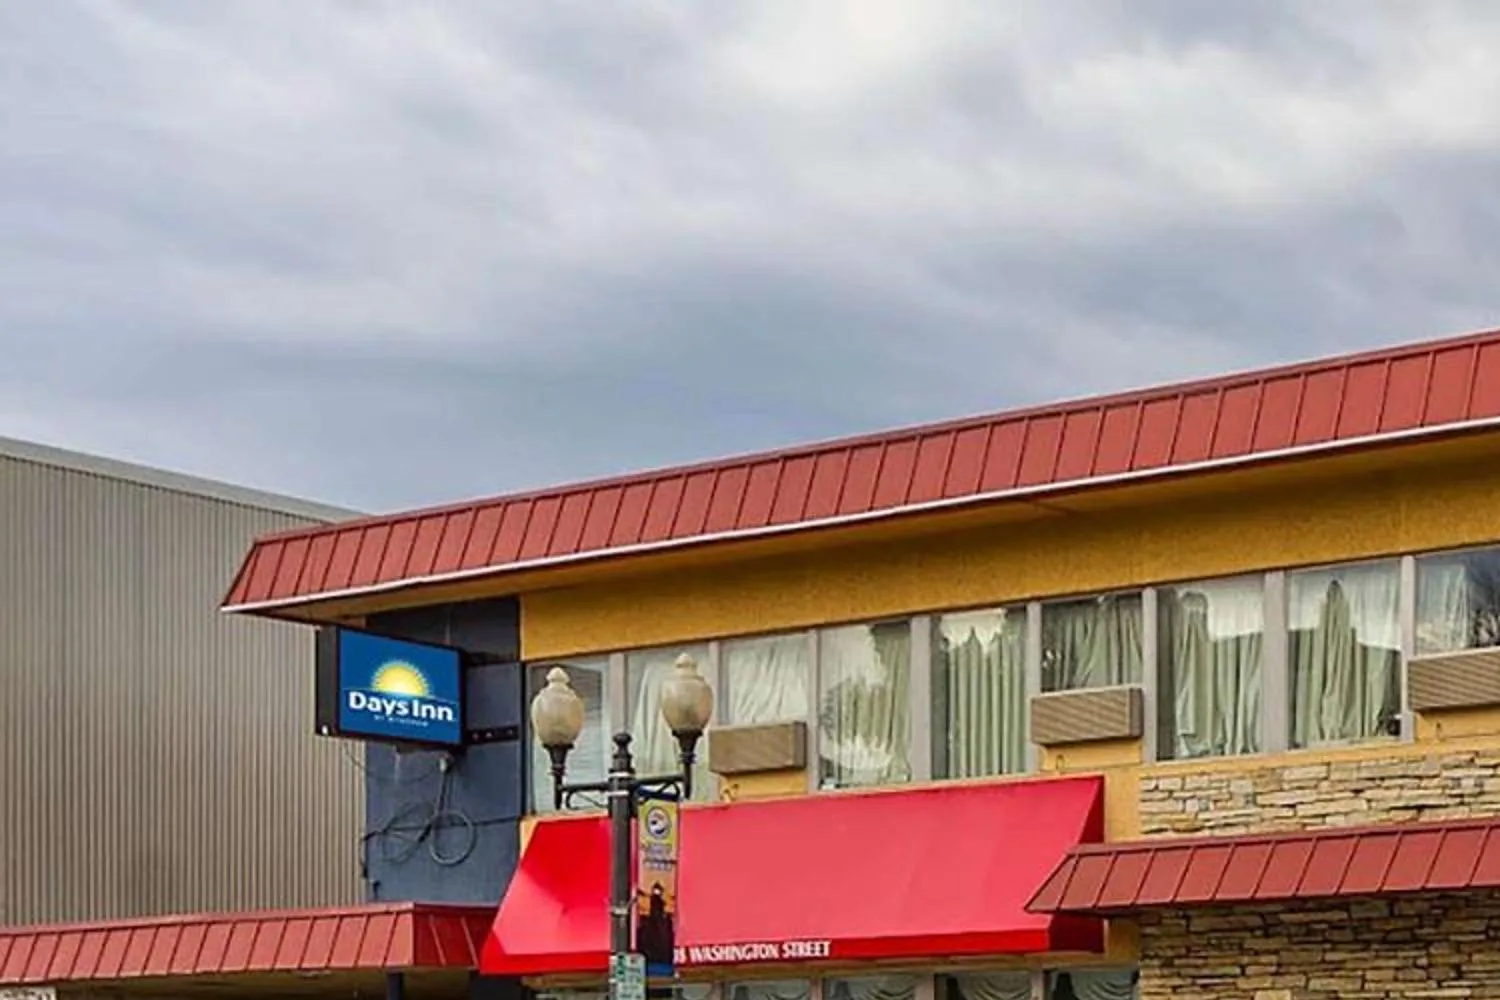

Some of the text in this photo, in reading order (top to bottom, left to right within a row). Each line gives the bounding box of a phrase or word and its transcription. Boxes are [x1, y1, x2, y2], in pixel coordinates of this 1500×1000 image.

[349, 691, 409, 716] Days
[412, 698, 454, 722] Inn
[689, 943, 780, 963] WASHINGTON
[782, 940, 831, 959] STREET
